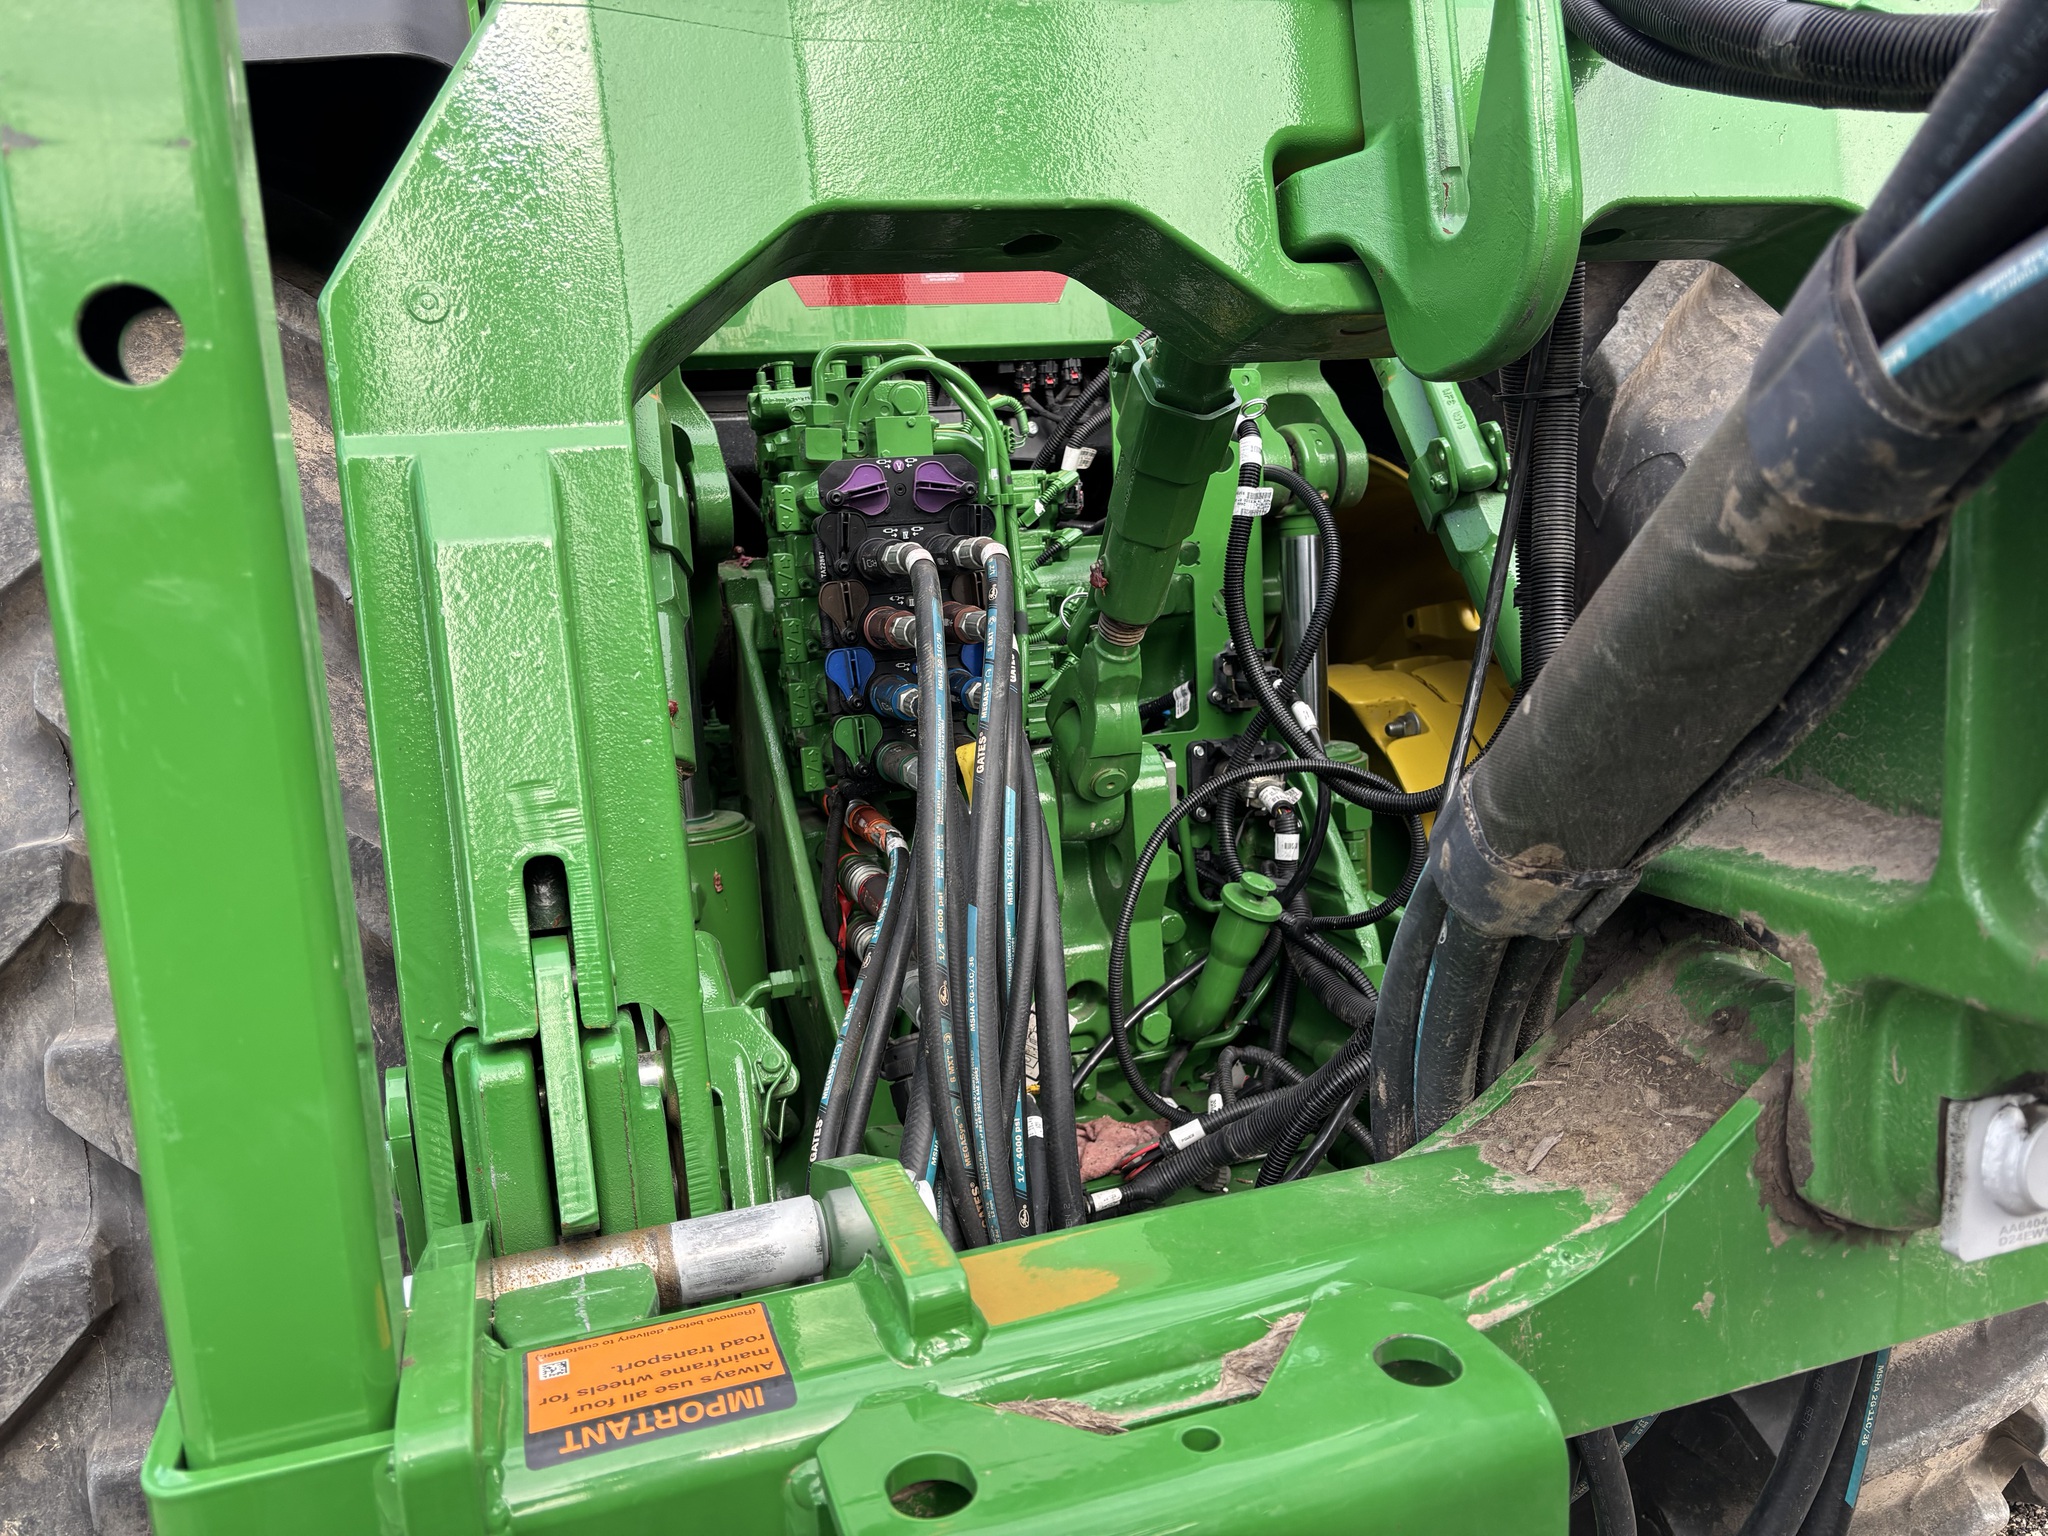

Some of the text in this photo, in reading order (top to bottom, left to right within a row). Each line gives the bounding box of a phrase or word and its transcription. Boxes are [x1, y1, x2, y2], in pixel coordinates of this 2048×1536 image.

[1014, 1118, 1022, 1132] psi
[1015, 1135, 1023, 1159] 4000
[666, 1319, 704, 1333] before
[706, 1307, 756, 1324] (Remove
[601, 1337, 614, 1346] to
[617, 1327, 664, 1344] delivery
[611, 1332, 766, 1373] road transport.
[538, 1347, 770, 1408] mainframe wheels for
[569, 1360, 774, 1417] Always use all four
[1861, 1365, 1885, 1446] MSHA 2G-11C/36
[558, 1385, 765, 1455] IMPORTANT
